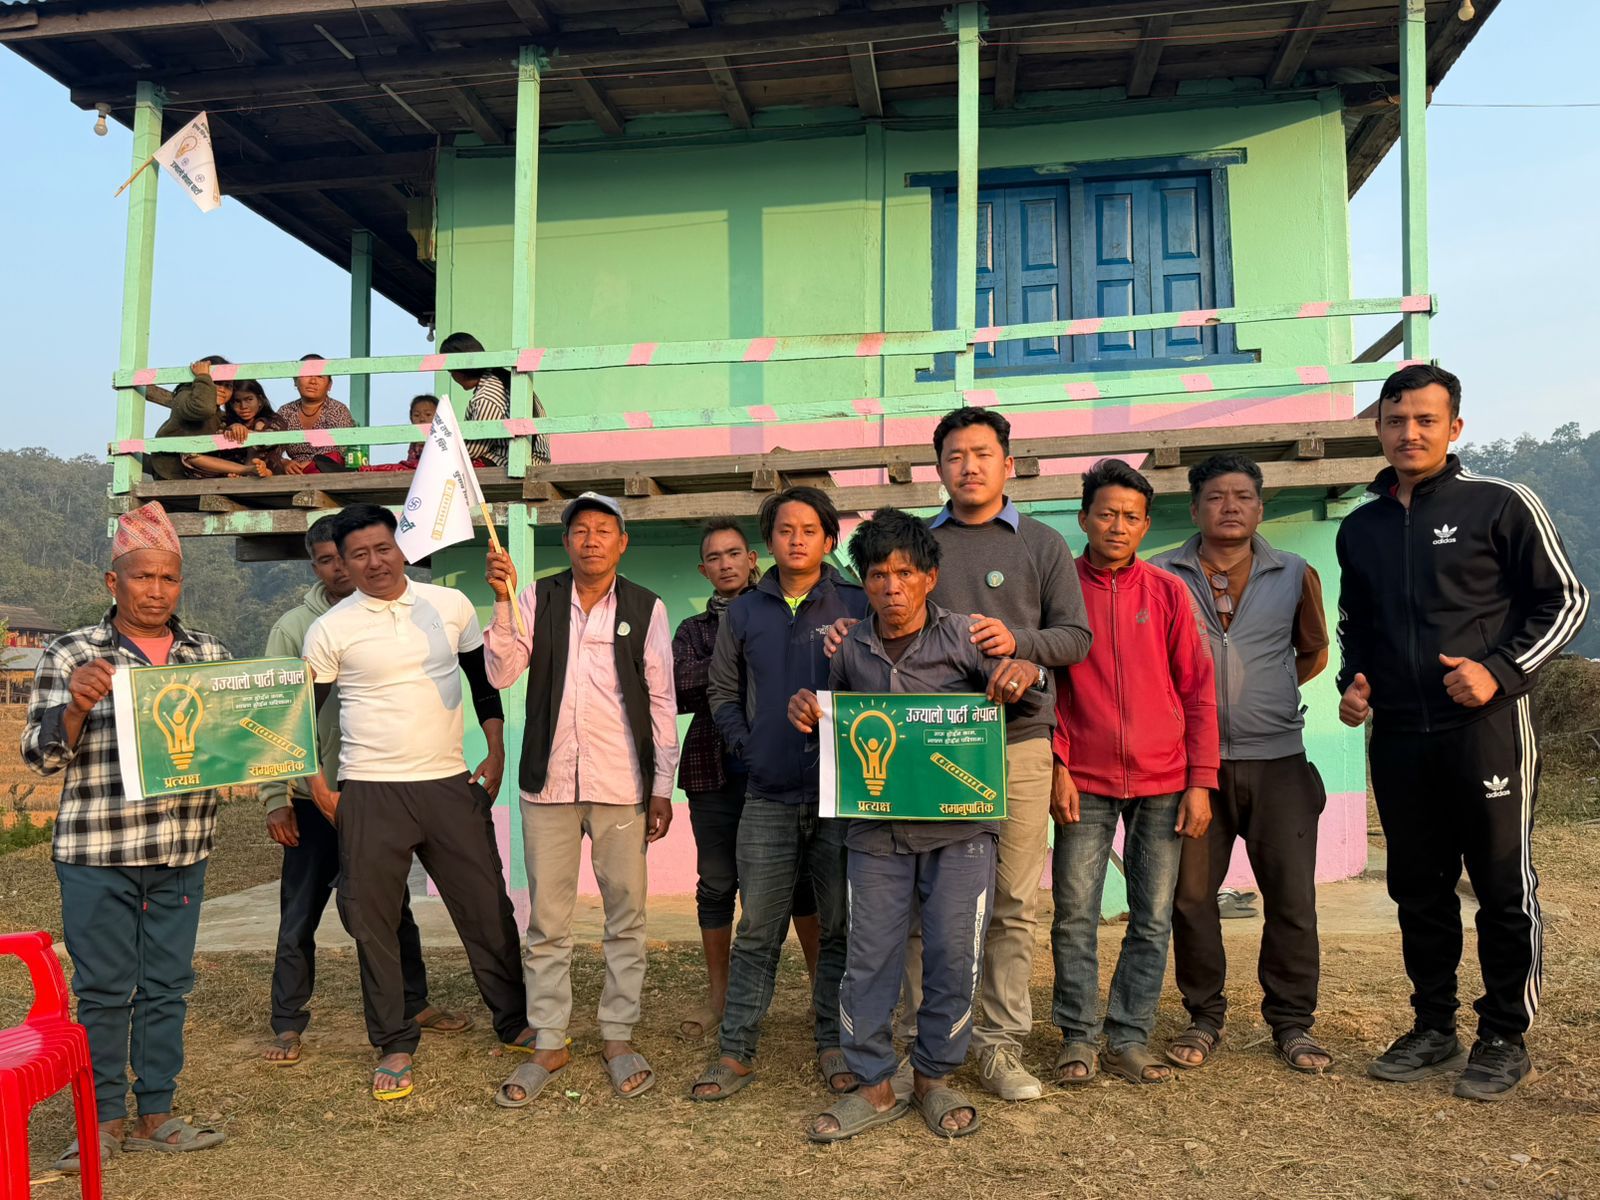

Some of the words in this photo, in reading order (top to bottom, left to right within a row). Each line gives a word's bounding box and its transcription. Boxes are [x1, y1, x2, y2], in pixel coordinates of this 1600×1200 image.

[1432, 537, 1457, 545] adidas
[210, 671, 251, 692] उज्यालो
[252, 668, 275, 688] पार्टी
[278, 668, 305, 686] नेपाल
[905, 704, 944, 724] उज्यालो
[946, 704, 969, 724] पार्टी
[971, 705, 999, 722] नेपाल
[163, 773, 201, 789] प्रत्यक्ष
[249, 759, 305, 777] समानुपातिक
[1485, 789, 1511, 799] adidas
[857, 800, 891, 813] प्रत्यक्ष
[939, 800, 995, 816] समानुपातिक
